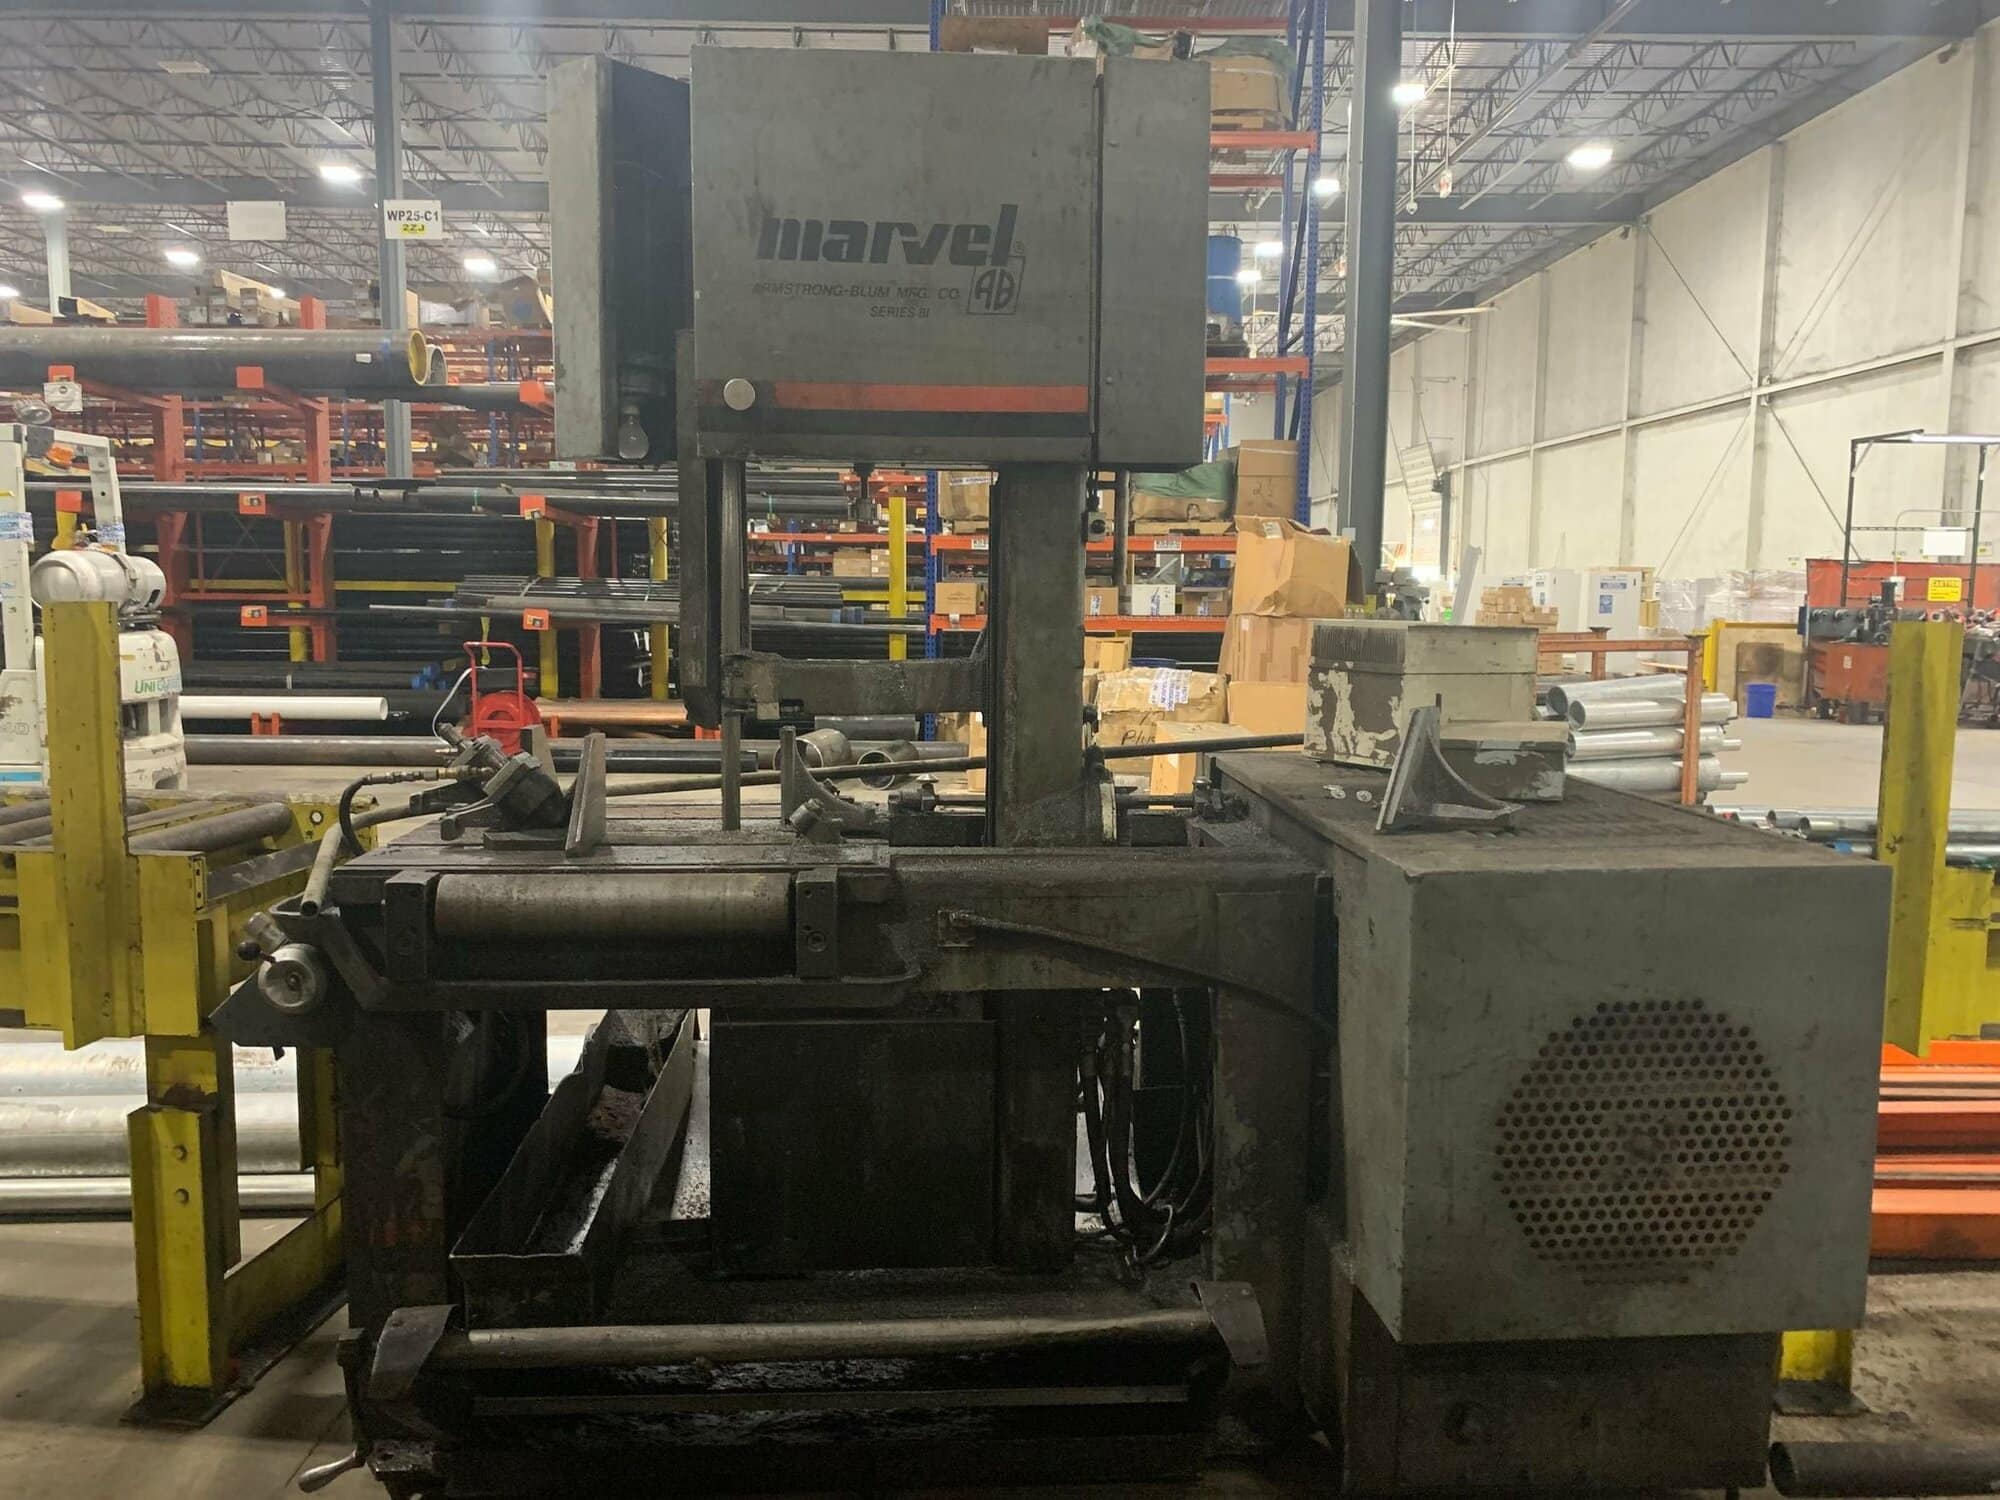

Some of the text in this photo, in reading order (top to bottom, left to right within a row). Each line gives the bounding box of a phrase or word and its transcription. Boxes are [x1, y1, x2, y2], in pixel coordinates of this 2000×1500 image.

[387, 210, 439, 221] WP25-C1
[757, 204, 1018, 266] marvel
[869, 305, 916, 319] SERIES
